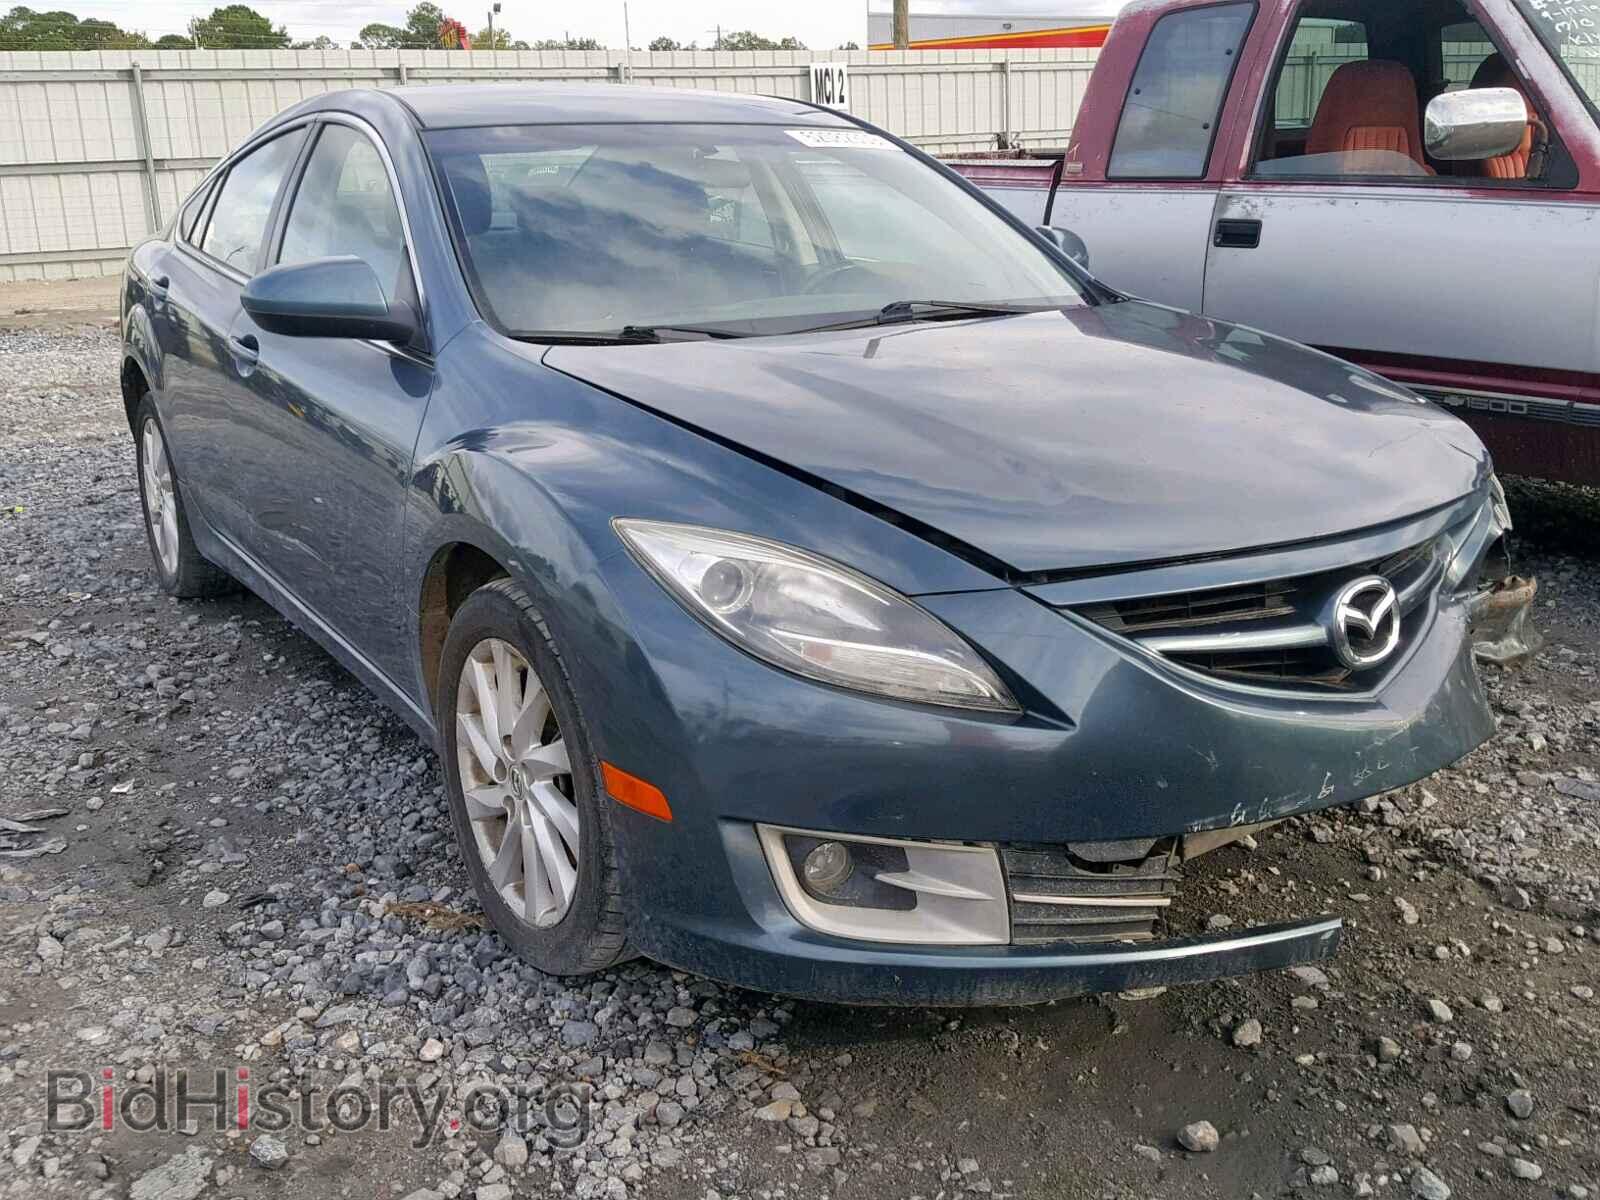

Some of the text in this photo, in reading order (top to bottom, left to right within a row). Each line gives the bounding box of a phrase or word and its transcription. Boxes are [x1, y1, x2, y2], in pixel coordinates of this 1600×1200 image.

[815, 68, 845, 104] MCI 2
[1466, 397, 1528, 414] 1500
